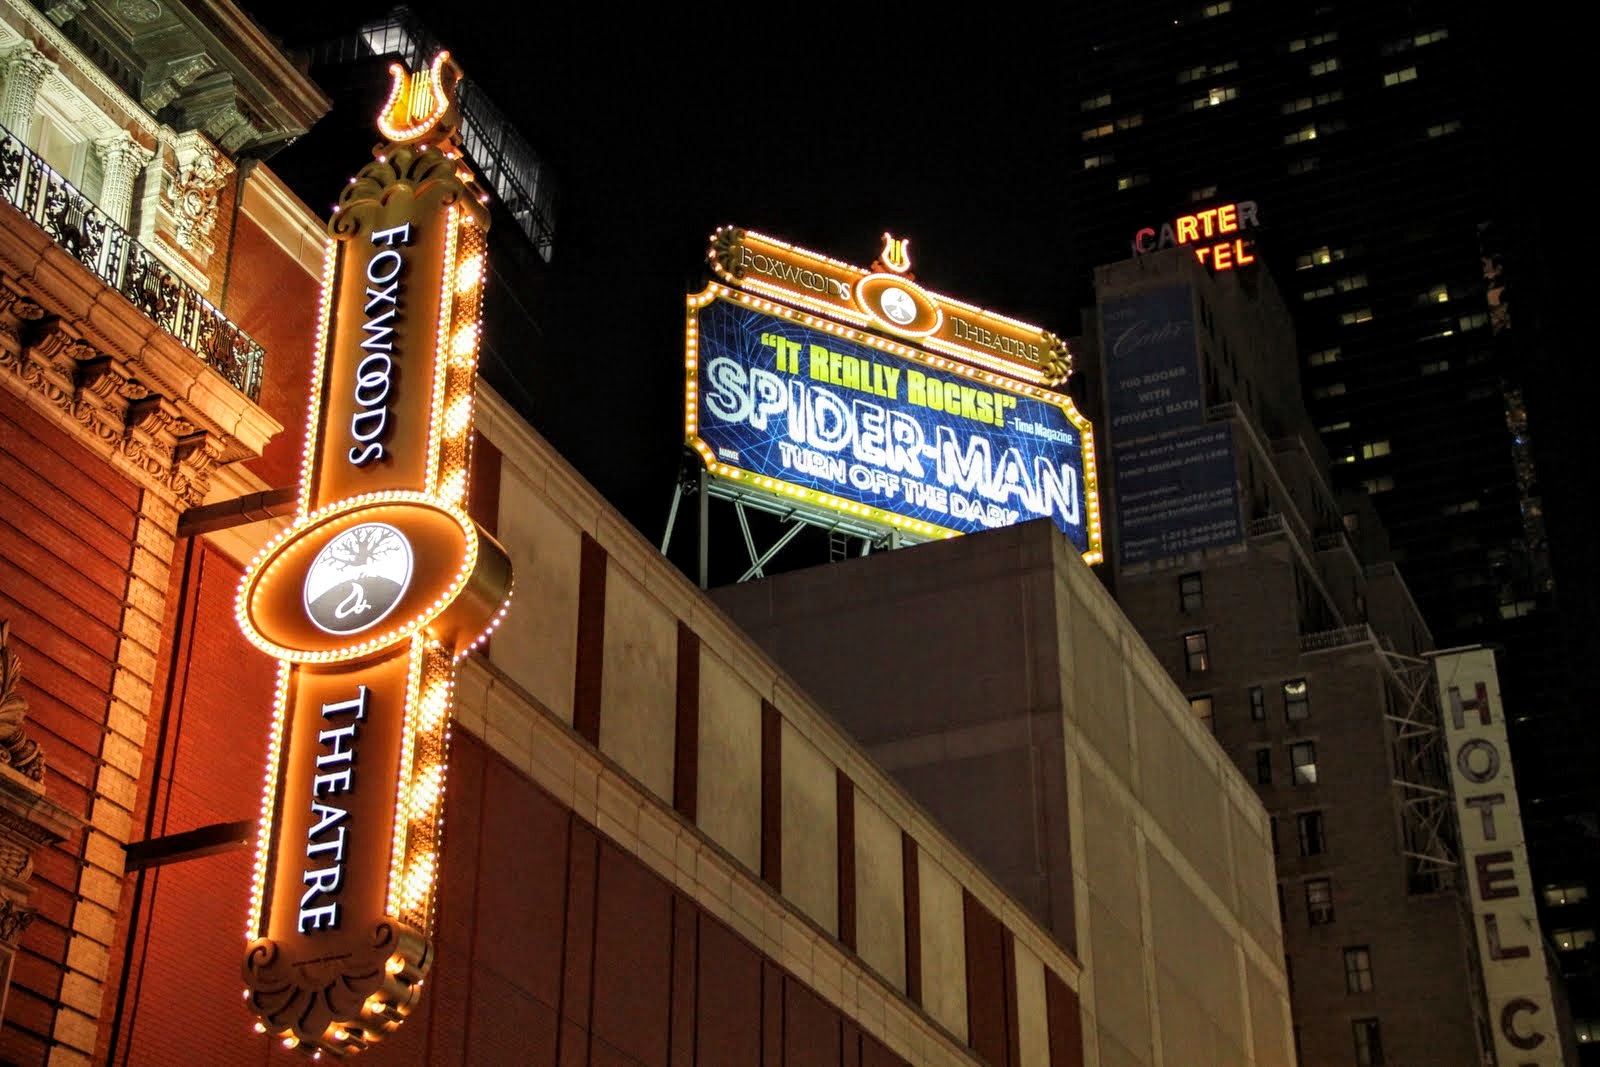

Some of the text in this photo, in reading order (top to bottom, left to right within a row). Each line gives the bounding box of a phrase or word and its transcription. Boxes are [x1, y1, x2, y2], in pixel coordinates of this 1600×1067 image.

[1135, 200, 1260, 253] CARTER
[740, 246, 1040, 363] FOXWOODS THEATRE
[348, 222, 410, 464] FOXWOODS
[809, 344, 900, 400] REALLY
[1138, 388, 1170, 403] WITH
[1143, 367, 1187, 385] ROOMS
[706, 357, 1079, 525] SPIDER-MAN
[1035, 424, 1073, 446] Magazine
[1112, 400, 1199, 427] PRIVATE BATH
[719, 447, 740, 460] MARVEL
[778, 440, 847, 484] TURN
[848, 464, 899, 499] OFF
[901, 478, 949, 514] THE
[298, 685, 367, 932] THEATRE
[1448, 682, 1545, 1067] HOTEL C
